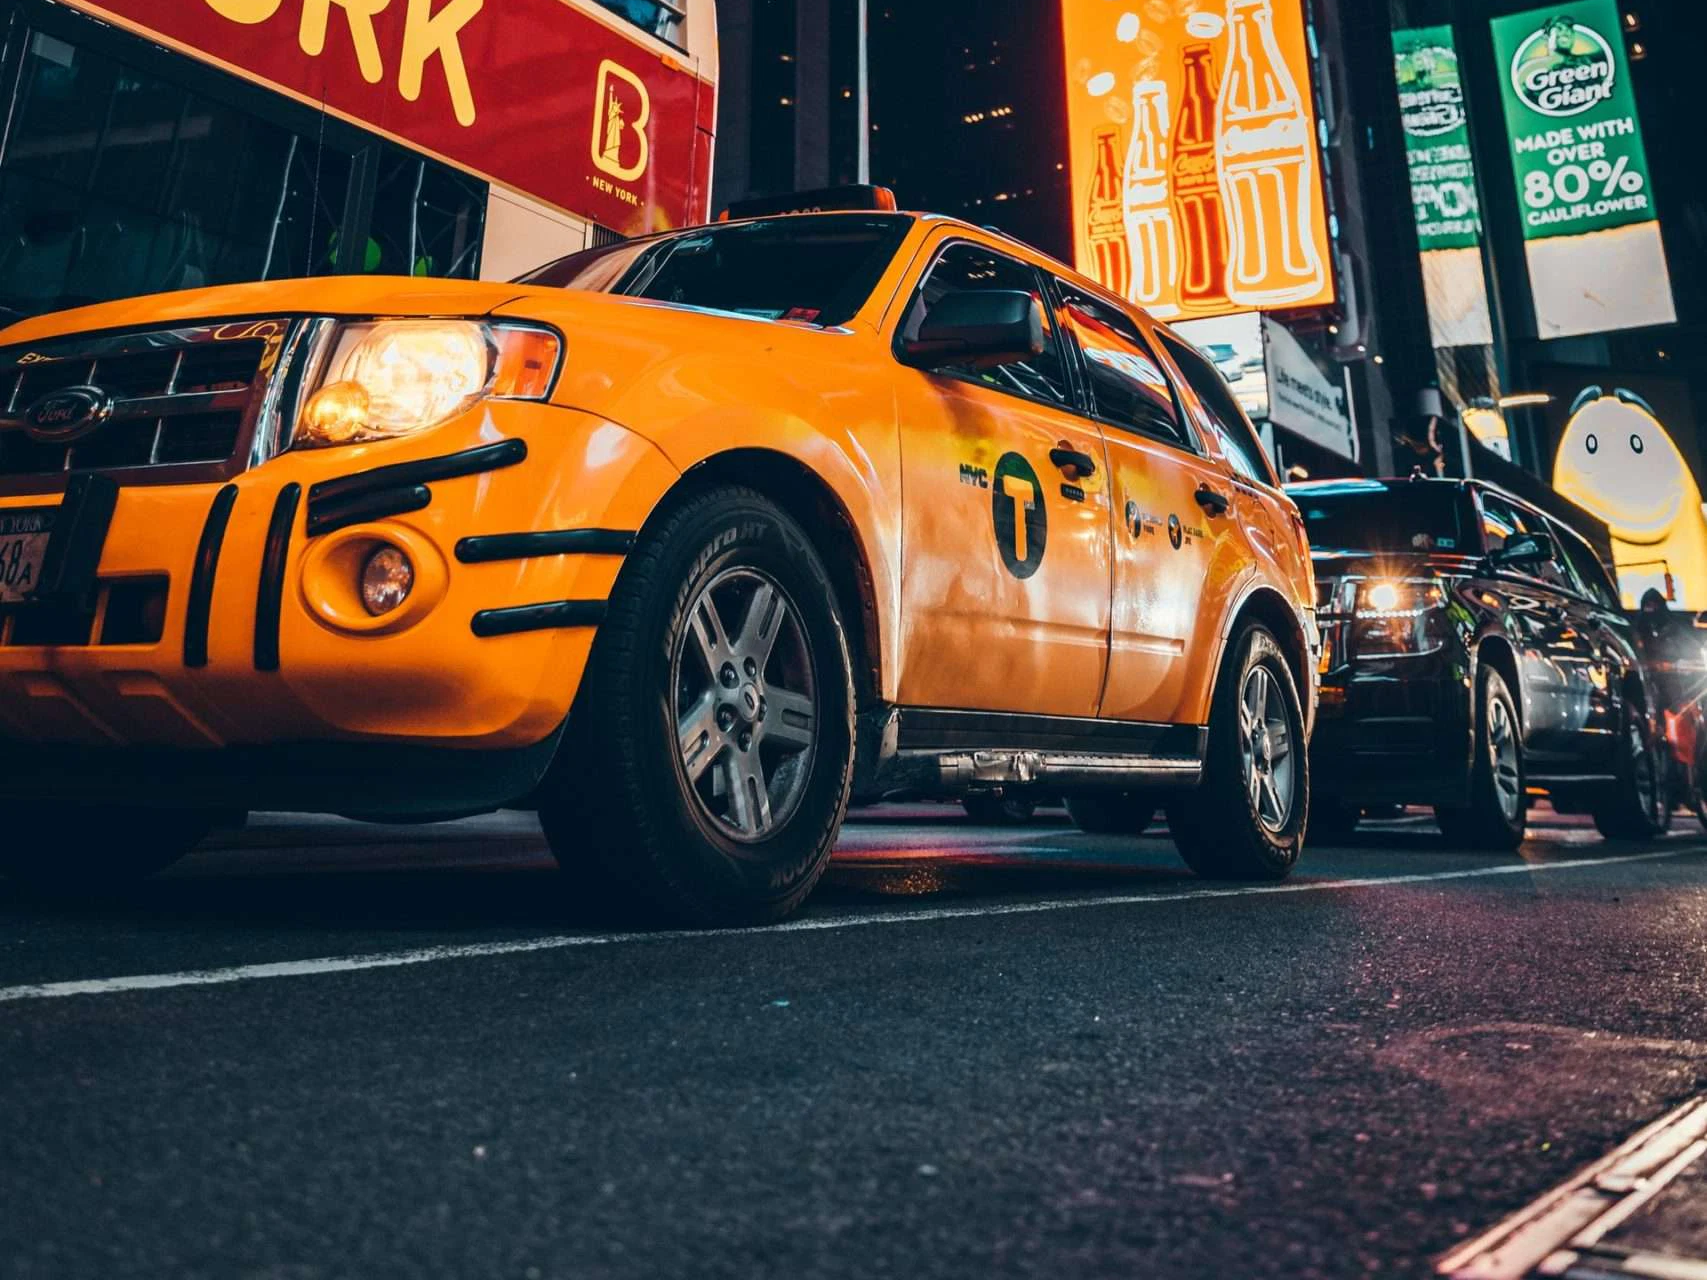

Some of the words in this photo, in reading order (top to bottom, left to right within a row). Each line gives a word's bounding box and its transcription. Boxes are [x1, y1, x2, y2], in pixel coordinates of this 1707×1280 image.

[1525, 61, 1608, 91] Green
[1538, 79, 1614, 110] Giant
[1514, 128, 1574, 154] MADE
[1576, 117, 1634, 140] WITH
[1546, 141, 1606, 166] OVER
[592, 175, 614, 195] NEW
[615, 185, 638, 207] YORK
[1524, 155, 1644, 209] 80%
[1527, 194, 1648, 226] CAULIFLOWER
[959, 463, 989, 489] NYC
